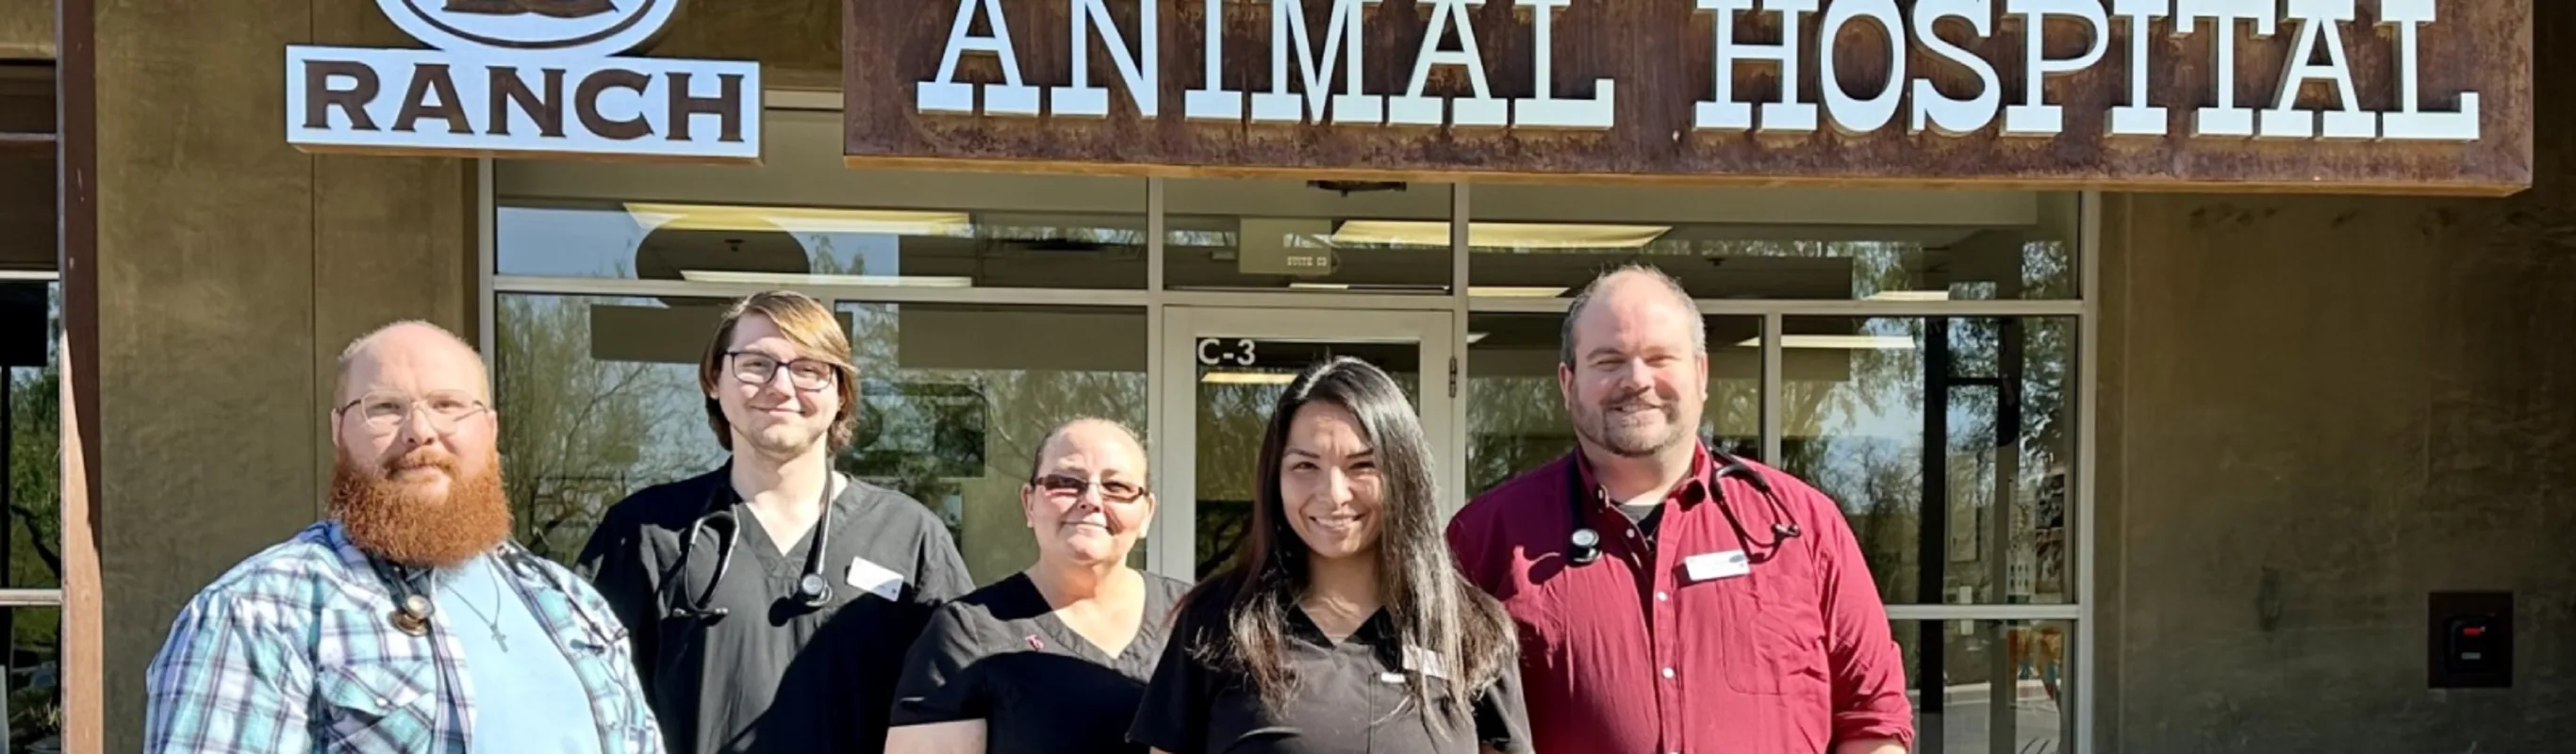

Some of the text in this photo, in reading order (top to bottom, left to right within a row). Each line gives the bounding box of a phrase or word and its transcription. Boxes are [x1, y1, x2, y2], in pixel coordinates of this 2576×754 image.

[302, 59, 745, 142] RANCH
[916, 0, 2480, 139] ANIMAL HOSPITAL
[1197, 338, 1256, 366] C-3
